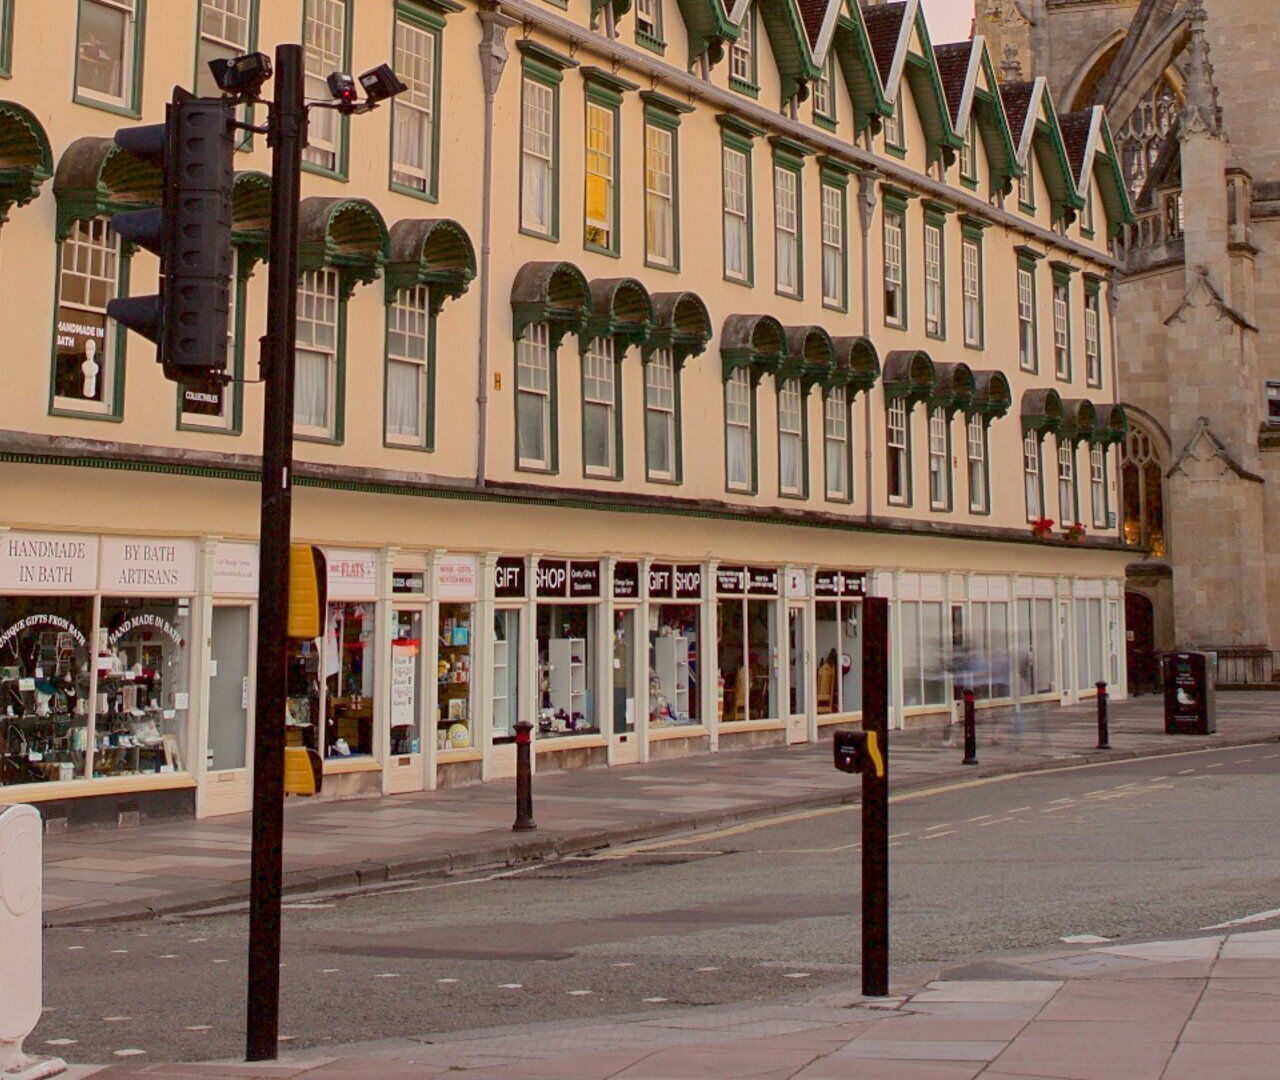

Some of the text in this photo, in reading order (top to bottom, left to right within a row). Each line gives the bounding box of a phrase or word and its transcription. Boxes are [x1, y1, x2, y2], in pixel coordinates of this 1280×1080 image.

[96, 327, 104, 338] IN
[8, 540, 85, 559] HANDMADE
[124, 545, 175, 562] BY BATH
[19, 566, 73, 583] IN BATH
[119, 569, 178, 585] ARTISANS
[341, 562, 365, 577] FLATS
[495, 567, 520, 588] GIFT
[536, 568, 566, 589] SHOP
[649, 572, 669, 591] GIFT
[675, 572, 700, 591] SHOP
[26, 614, 48, 626] GIFTS
[48, 615, 69, 631] FROM
[68, 623, 86, 647] BATH
[109, 614, 182, 646] HAND MADE IN BATH
